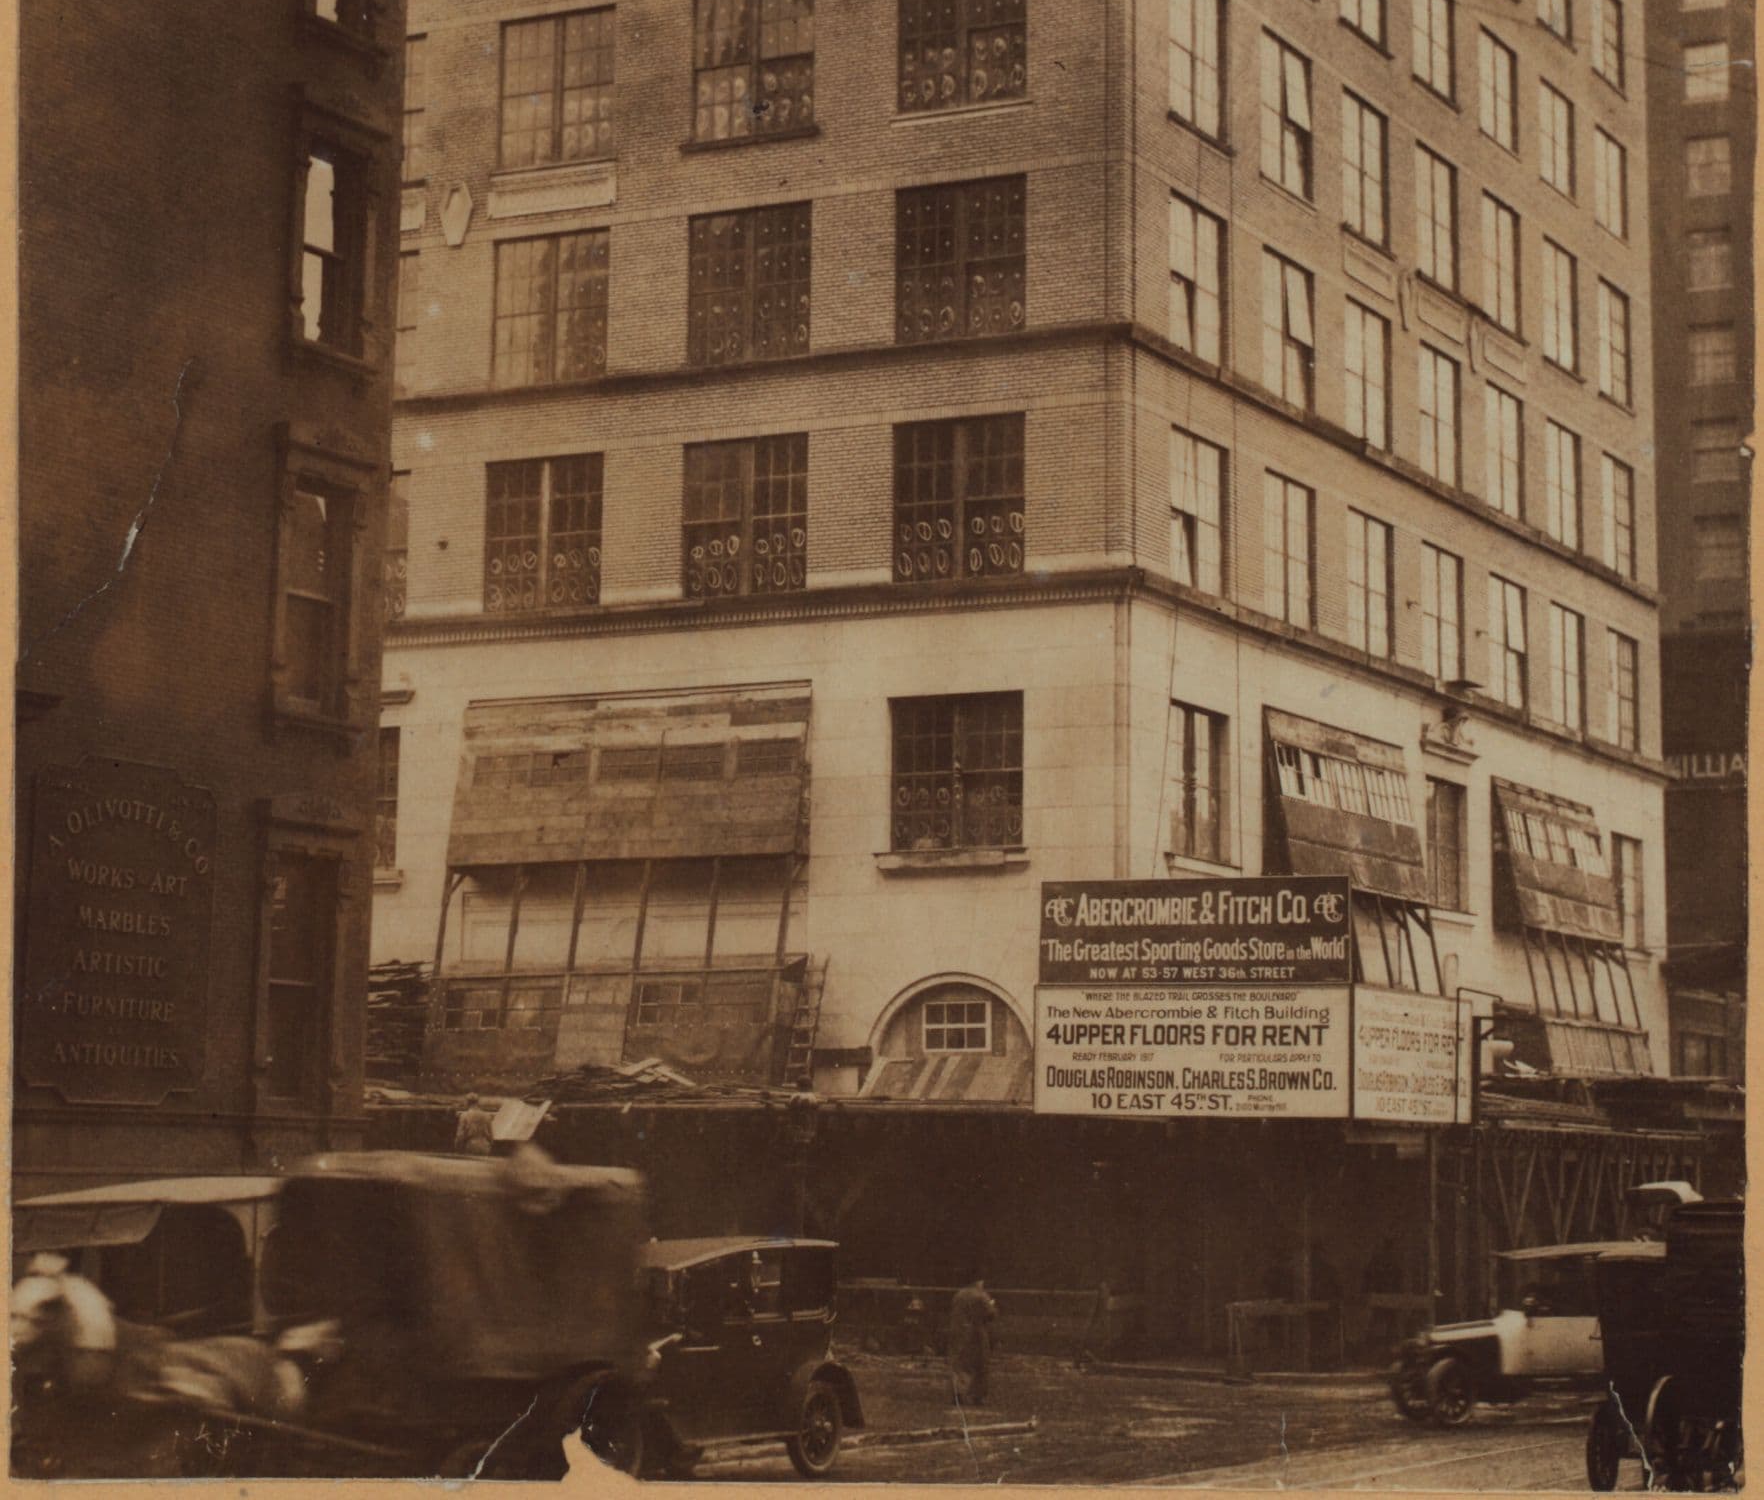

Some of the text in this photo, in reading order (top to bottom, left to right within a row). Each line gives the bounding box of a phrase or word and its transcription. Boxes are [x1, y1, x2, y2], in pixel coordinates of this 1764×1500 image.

[66, 798, 165, 834] OLIVOTTI
[67, 857, 188, 897] WORKS ART
[79, 905, 171, 936] MARBLES
[1075, 892, 1197, 926] ABERCROMBIE
[1200, 891, 1216, 924] &
[1218, 891, 1272, 924] FITCH
[1277, 889, 1311, 924] CO.
[73, 949, 168, 977] ARTISTIC
[1074, 938, 1139, 962] Greatest
[1141, 937, 1201, 965] Sporting
[1203, 936, 1247, 961] Goods
[1249, 936, 1285, 960] Store
[1296, 945, 1311, 960] the
[1089, 967, 1118, 979] NOW
[1122, 967, 1137, 979] AT
[1142, 967, 1178, 979] 53-57
[1182, 967, 1216, 979] WEST
[1250, 966, 1295, 979] STREET
[62, 990, 176, 1023] FURNITURE
[1047, 1005, 1330, 1024] The New Abercrombie & Fitch Building
[1130, 1024, 1205, 1046] FLOORS
[1212, 1025, 1256, 1046] FOR
[1262, 1025, 1330, 1047] RENT
[54, 1042, 180, 1068] ANTIQUITIES
[1219, 1053, 1235, 1062] FOR
[1046, 1065, 1105, 1088] DOUGLAS
[1182, 1068, 1245, 1090] CHARLES
[1312, 1068, 1337, 1091] CO.
[1091, 1093, 1112, 1109] 10
[1117, 1094, 1165, 1110] EAST
[1208, 1094, 1233, 1111] ST.
